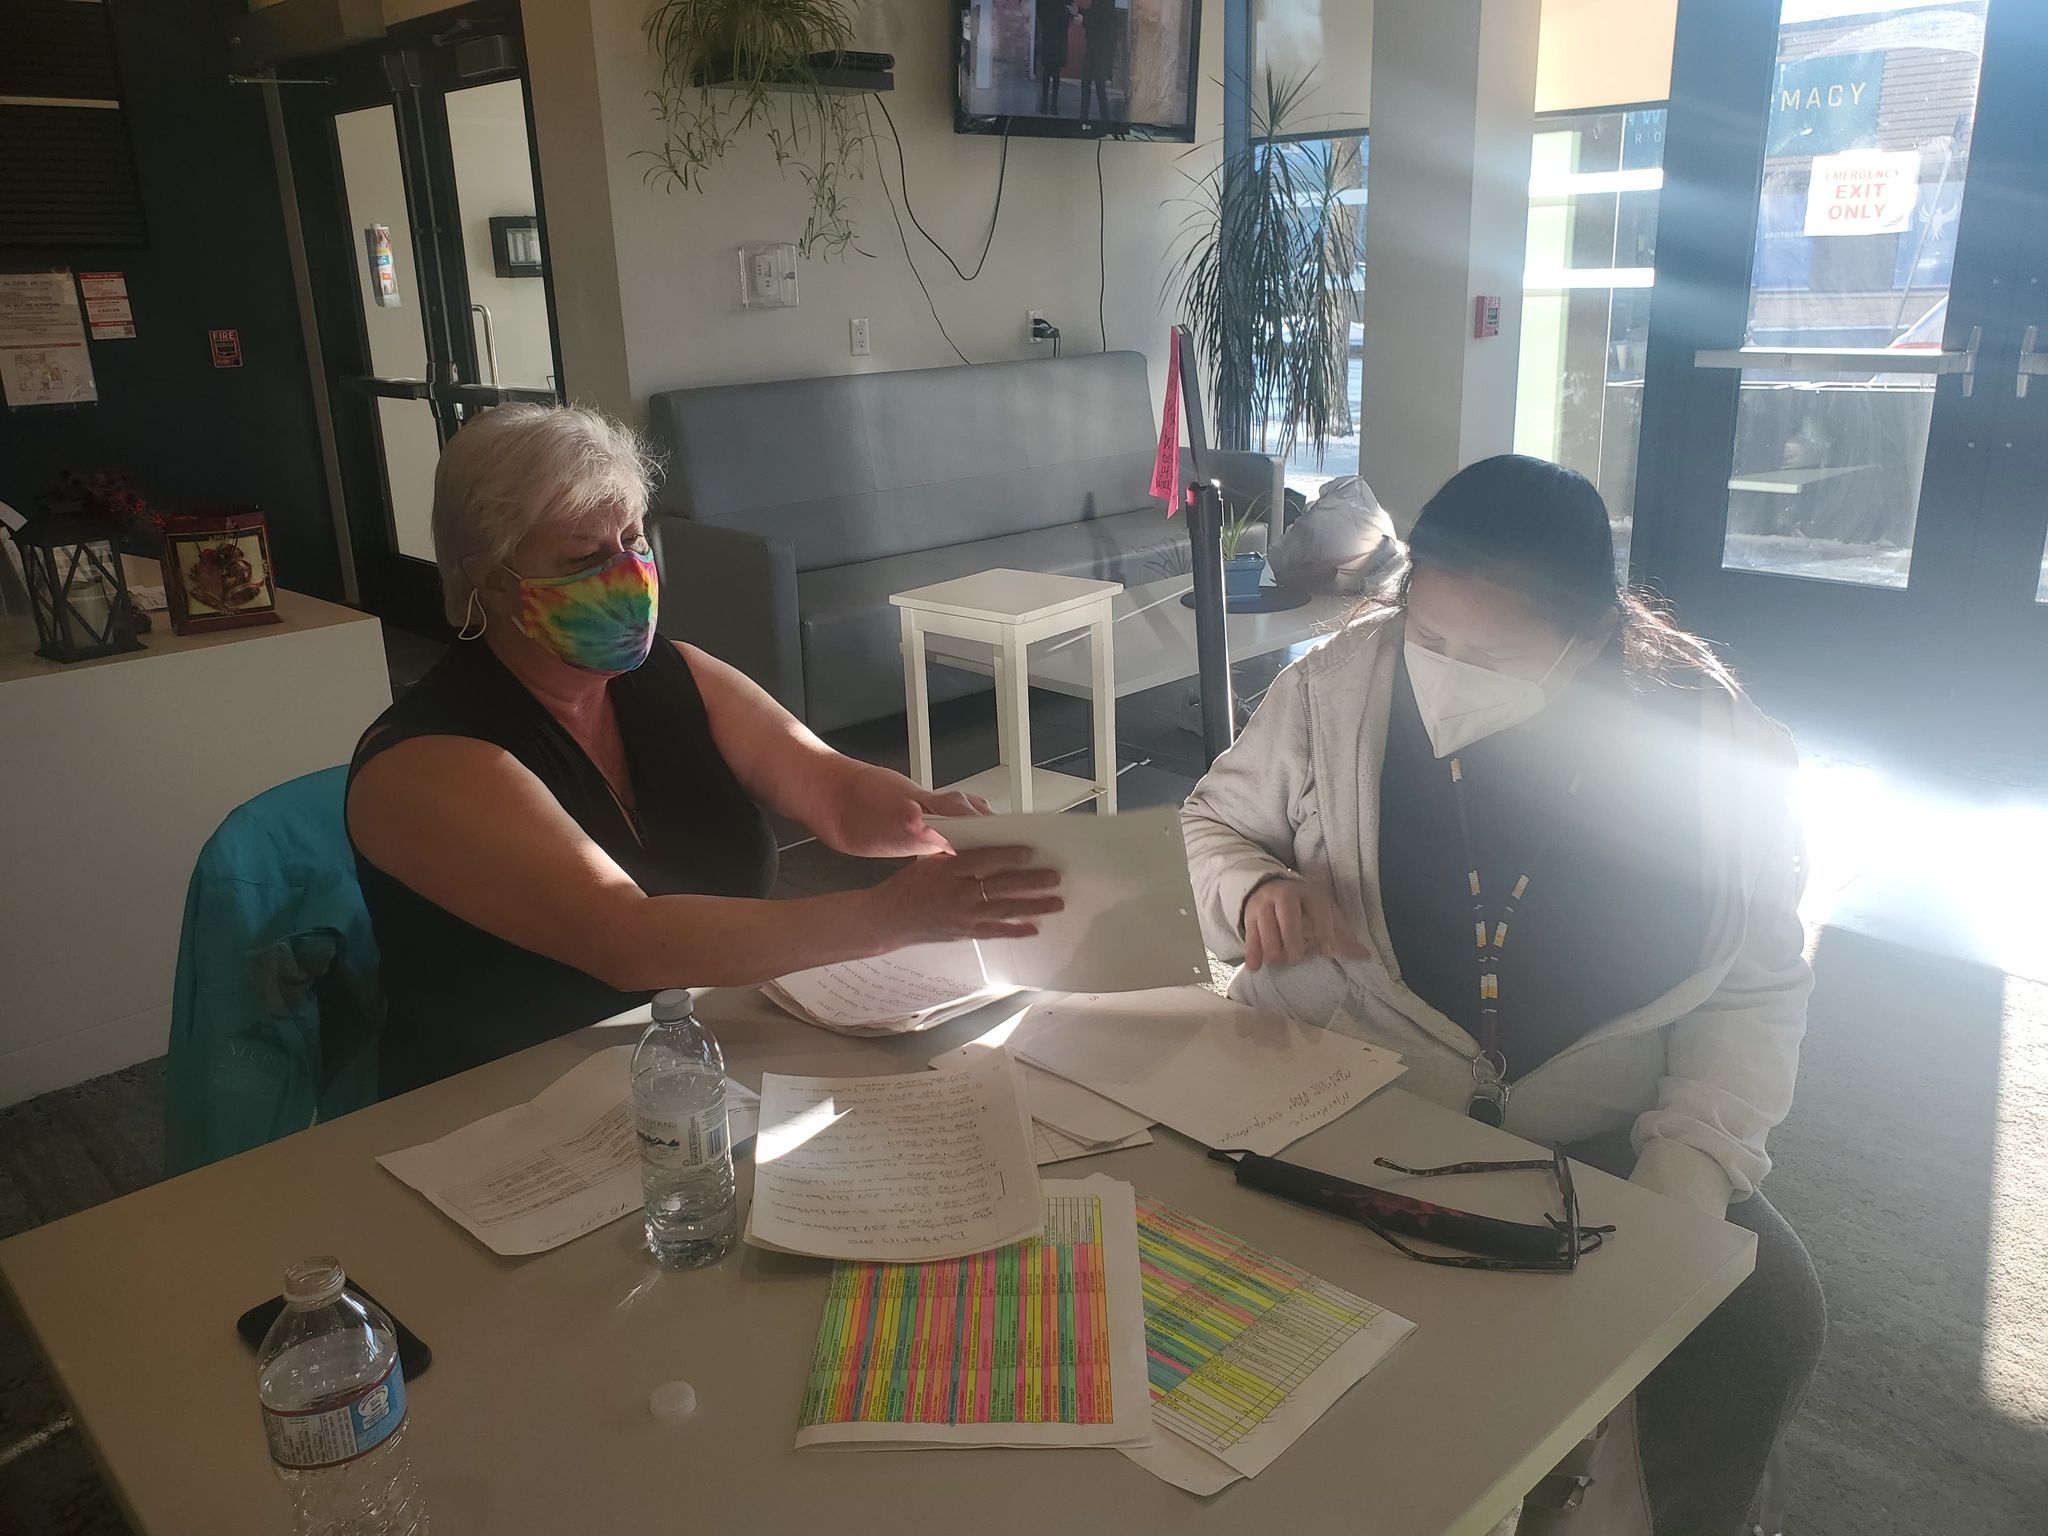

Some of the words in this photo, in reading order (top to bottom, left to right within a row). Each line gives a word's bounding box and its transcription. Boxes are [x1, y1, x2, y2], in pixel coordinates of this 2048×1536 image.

[1825, 169, 1899, 181] EMERGENCY
[1835, 183, 1886, 199] EXIT
[1828, 204, 1886, 220] ONLY
[212, 331, 236, 341] FIRE
